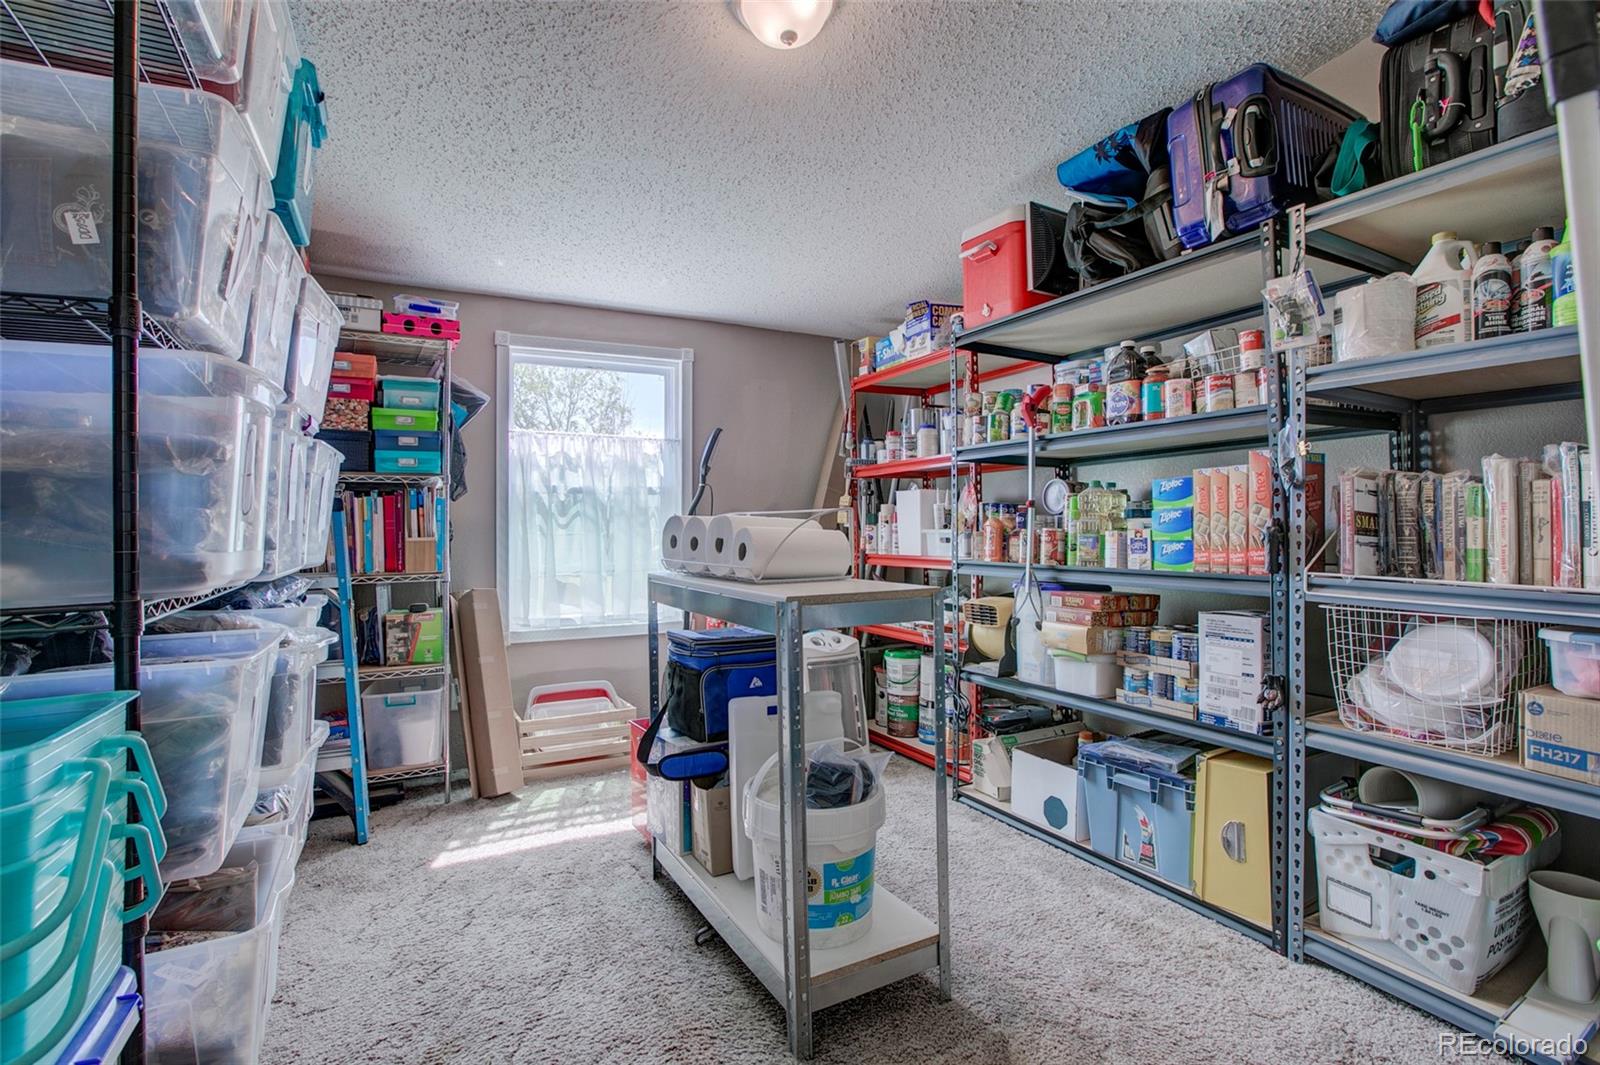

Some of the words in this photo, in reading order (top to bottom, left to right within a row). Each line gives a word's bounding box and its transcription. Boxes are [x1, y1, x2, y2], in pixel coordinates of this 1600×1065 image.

[1160, 479, 1184, 492] Ziploc
[1254, 470, 1268, 502] Chex
[1199, 486, 1208, 511] Chex
[1216, 486, 1226, 511] Chex
[1234, 483, 1245, 510] Chex
[1160, 511, 1183, 524] Ziploc
[1355, 514, 1378, 529] SMA
[1161, 543, 1185, 555] Ziploc
[1530, 744, 1581, 765] FH217
[841, 873, 860, 884] Clear
